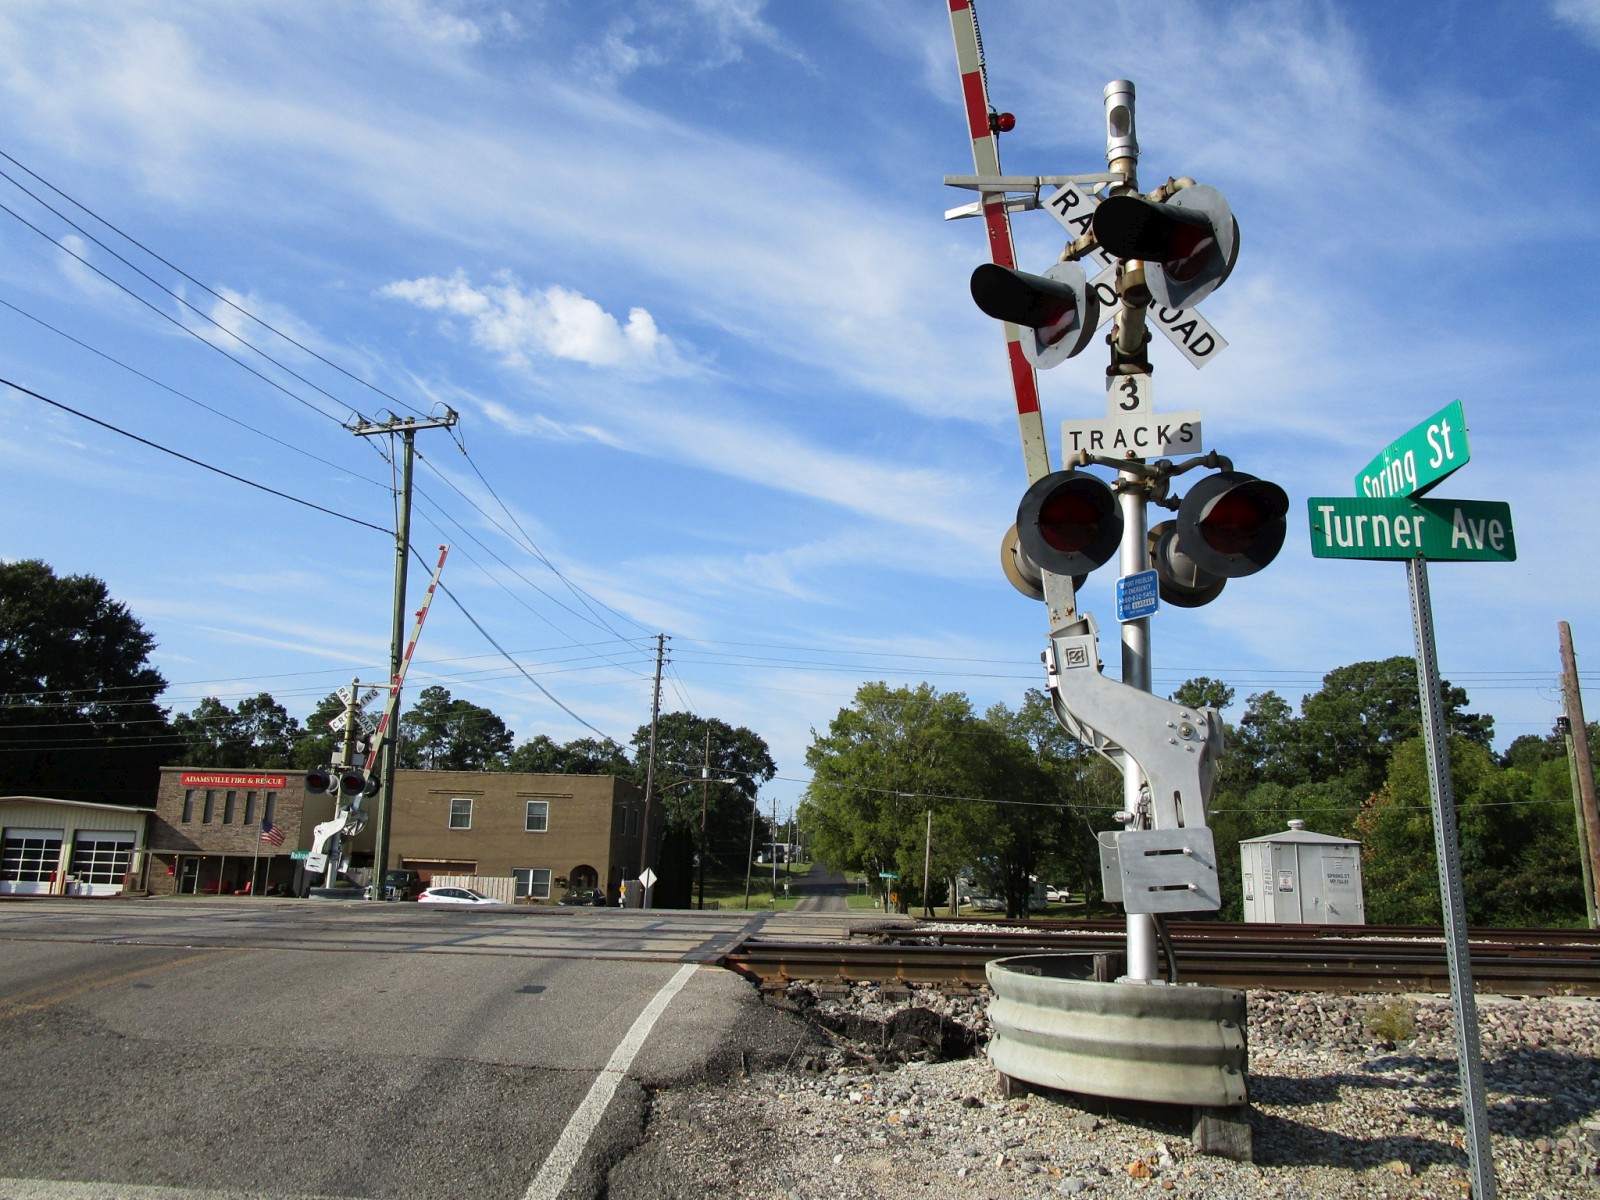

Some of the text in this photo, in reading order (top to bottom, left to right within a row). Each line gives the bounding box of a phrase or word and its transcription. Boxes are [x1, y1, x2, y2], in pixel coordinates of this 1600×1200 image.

[1119, 383, 1140, 411] 3
[1069, 422, 1194, 451] TRACKS
[1363, 418, 1454, 498] Spring St
[1318, 505, 1505, 551] Turner Ave
[184, 775, 230, 784] ADAMSVILLE
[230, 776, 246, 784] FIRE
[255, 777, 283, 785] RESCUE
